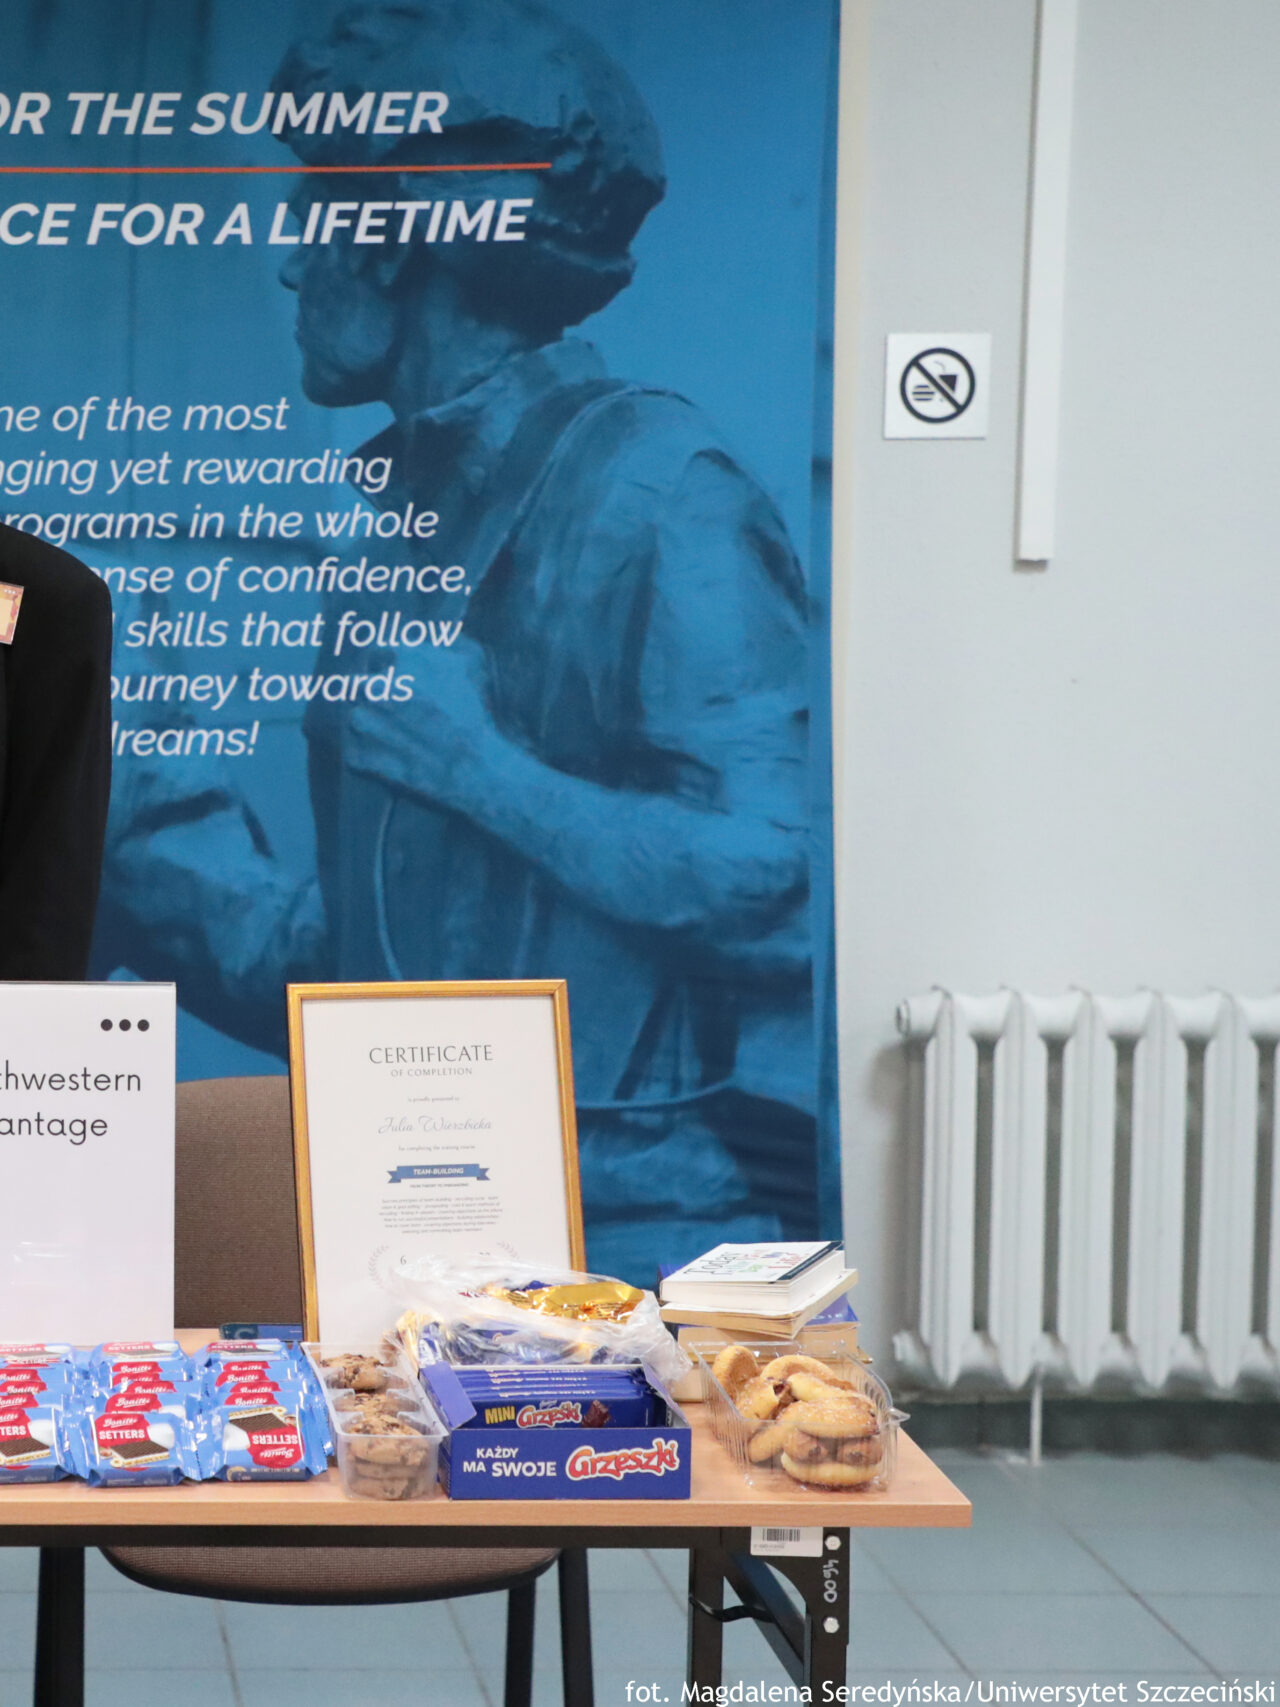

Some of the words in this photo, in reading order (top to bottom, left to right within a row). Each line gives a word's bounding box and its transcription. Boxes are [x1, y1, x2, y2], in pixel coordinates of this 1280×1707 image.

[68, 91, 181, 135] THE
[189, 91, 449, 135] SUMMER
[86, 201, 203, 246] FOR
[213, 201, 257, 246] A
[268, 198, 534, 246] LIFETIME
[52, 396, 100, 440] of
[106, 396, 172, 431] the
[183, 397, 290, 431] most
[106, 451, 172, 494] yet
[182, 449, 392, 494] rewarding
[189, 503, 225, 539] in
[238, 502, 305, 539] the
[315, 501, 440, 538] whole
[90, 566, 174, 593] nse
[186, 556, 233, 602] of
[237, 555, 473, 597] confidence,
[124, 611, 229, 648] skills
[241, 611, 323, 648] that
[334, 610, 463, 656] follow
[248, 666, 416, 703] towards
[111, 720, 260, 756] reams!
[369, 1044, 493, 1065] CERTIFICATE
[390, 1068, 404, 1078] OF
[407, 1067, 473, 1077] COMPLETION
[413, 1167, 464, 1176] TEAM-BUILDING
[484, 1406, 516, 1425] MINI
[99, 1428, 145, 1440] SETTERS
[252, 1434, 299, 1445] SETTERS
[476, 1445, 519, 1459] KAŻDY
[463, 1461, 487, 1473] MA
[491, 1461, 557, 1478] SWOJE
[566, 1438, 681, 1481] Grzeszki
